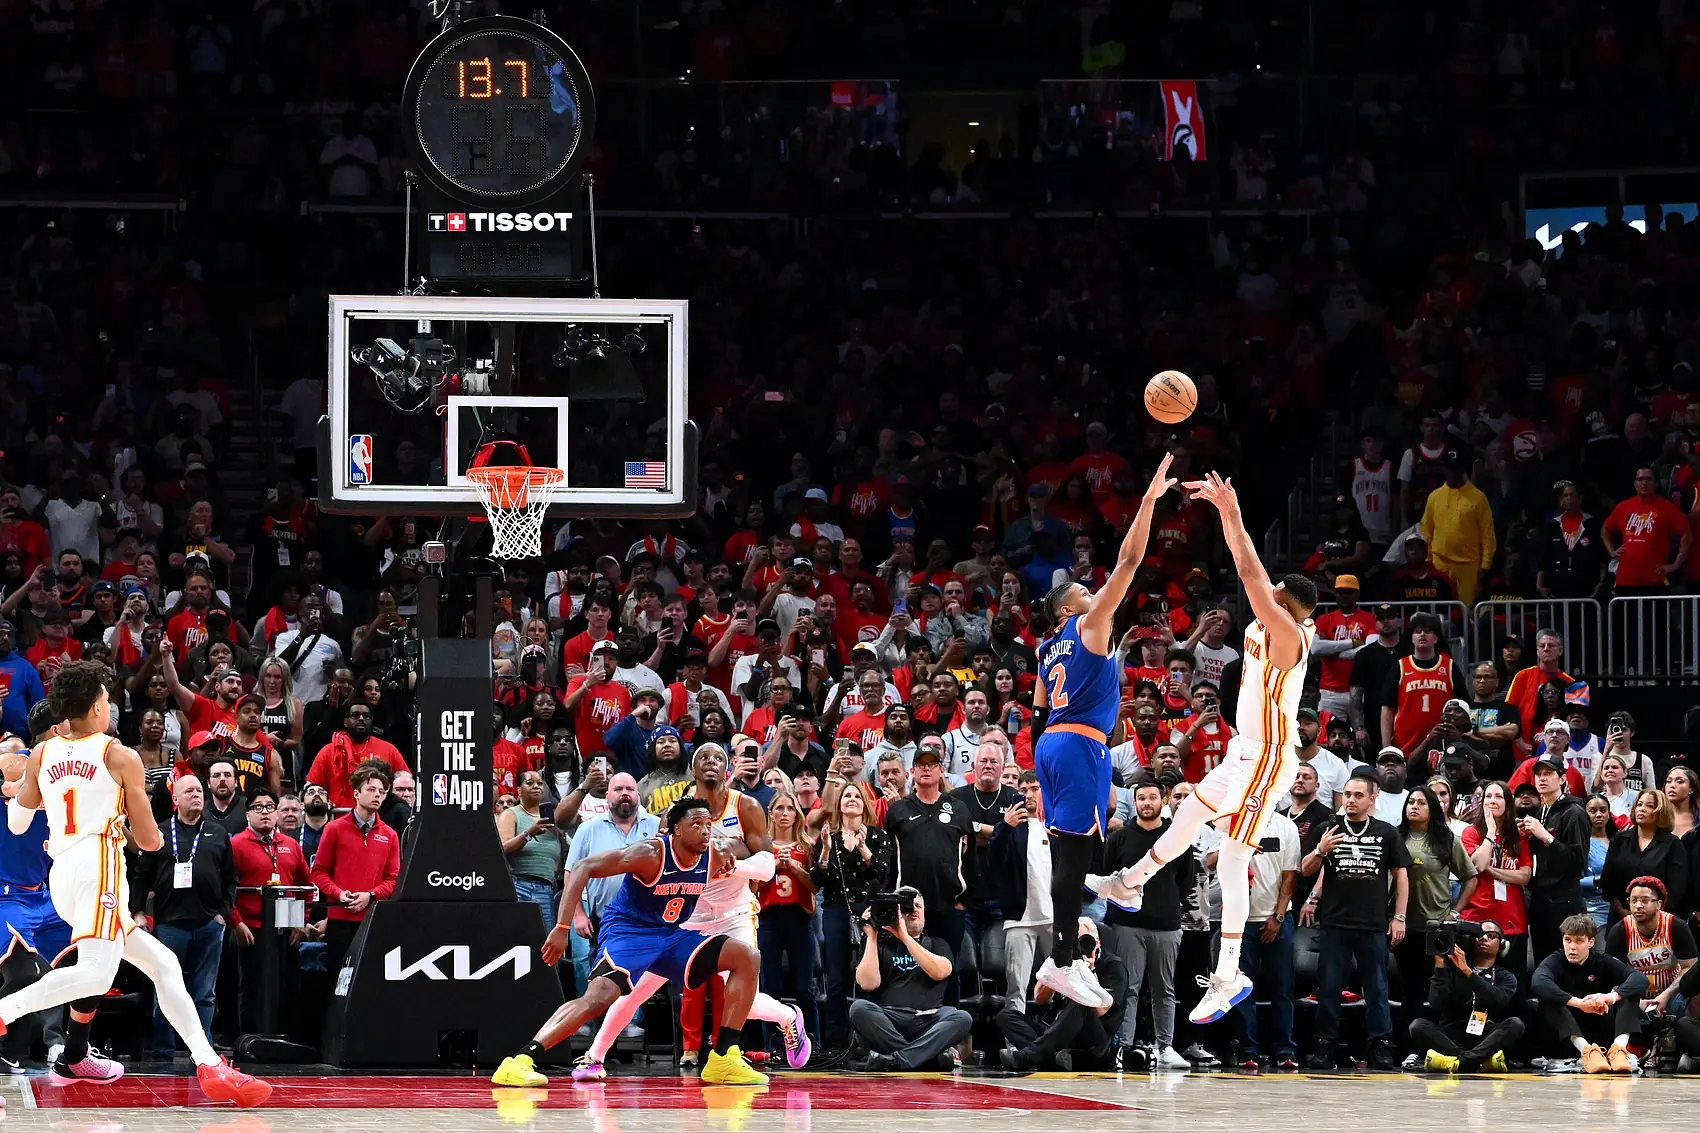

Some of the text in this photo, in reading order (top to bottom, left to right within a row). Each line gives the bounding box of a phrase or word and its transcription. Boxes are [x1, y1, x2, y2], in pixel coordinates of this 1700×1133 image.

[459, 57, 528, 98] 13.7
[469, 213, 573, 231] TISSOT
[352, 473, 366, 482] NBA
[1044, 640, 1075, 669] McBRIDE
[1201, 655, 1226, 668] VOTE
[1197, 671, 1222, 682] PEDR
[1204, 665, 1224, 675] FOR
[1048, 662, 1070, 709] 2
[1405, 680, 1448, 692] ATLANTA
[1421, 694, 1430, 712] 1
[441, 710, 475, 739] GET
[441, 742, 476, 771] THE
[961, 750, 970, 763] 5
[47, 761, 98, 784] JOHNSON
[449, 775, 484, 810] App
[62, 787, 79, 837] 1
[427, 871, 485, 890] Google
[653, 884, 708, 896] NEW YORK
[662, 898, 685, 924] 8
